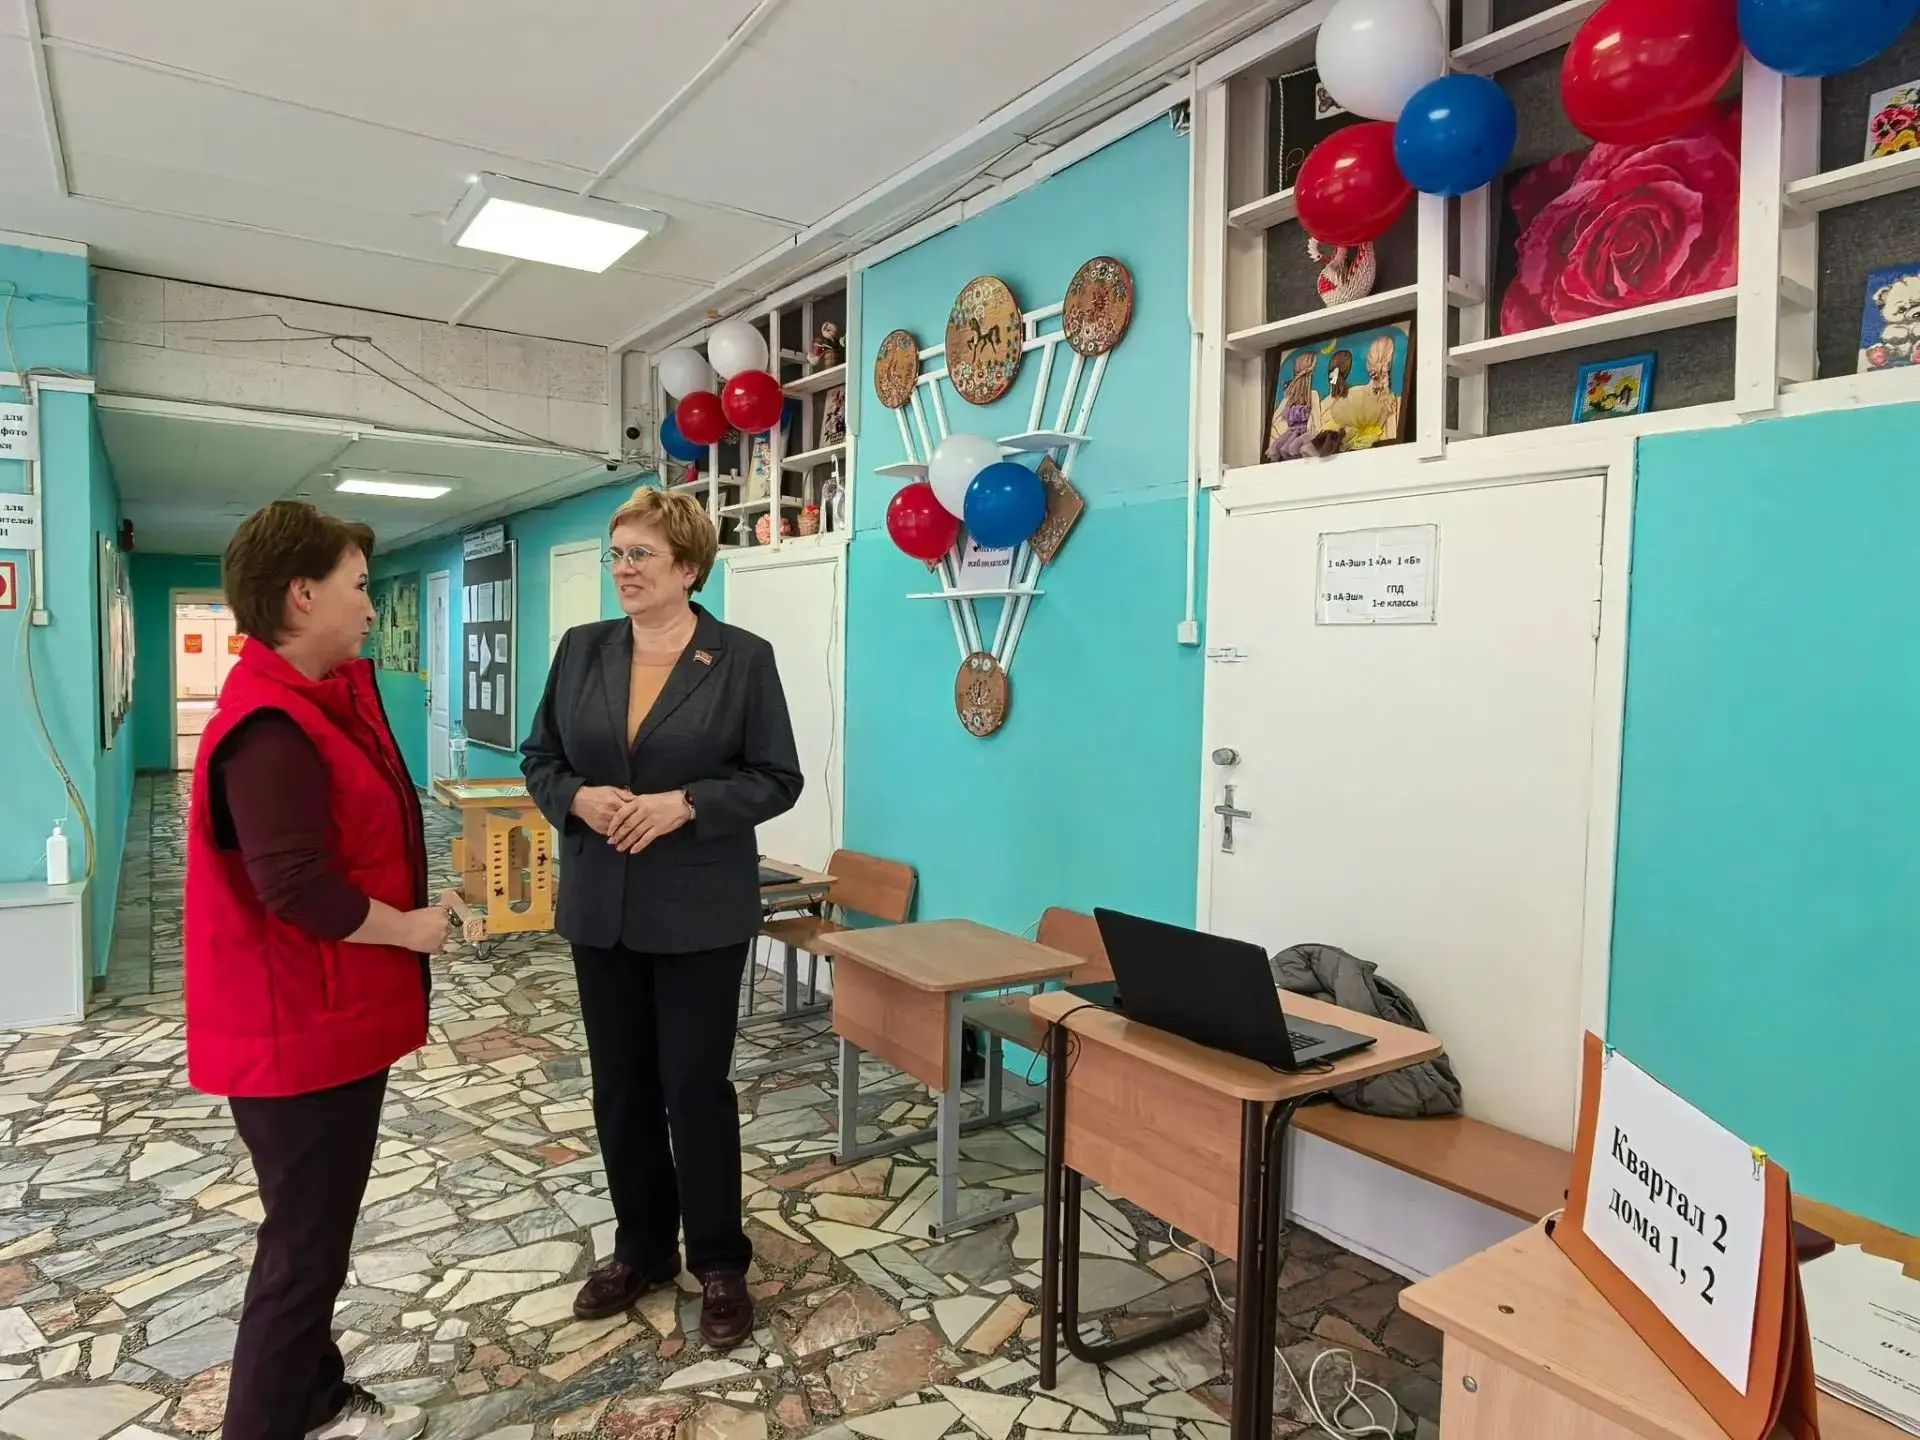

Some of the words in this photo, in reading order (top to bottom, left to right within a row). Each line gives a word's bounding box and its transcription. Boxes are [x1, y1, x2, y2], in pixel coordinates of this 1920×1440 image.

[3, 414, 23, 422] для
[4, 504, 24, 512] для
[0, 517, 34, 525] ителей
[1375, 558, 1392, 566] «А»
[1397, 557, 1402, 565] 1
[1404, 556, 1421, 565] «Б»
[1386, 585, 1405, 595] ГПД
[1326, 593, 1331, 601] 3
[1612, 1125, 1706, 1236] Квартал
[1712, 1214, 1728, 1254] 2
[1609, 1188, 1661, 1253] дома
[1669, 1236, 1686, 1284] 1,
[1700, 1265, 1715, 1305] 2
